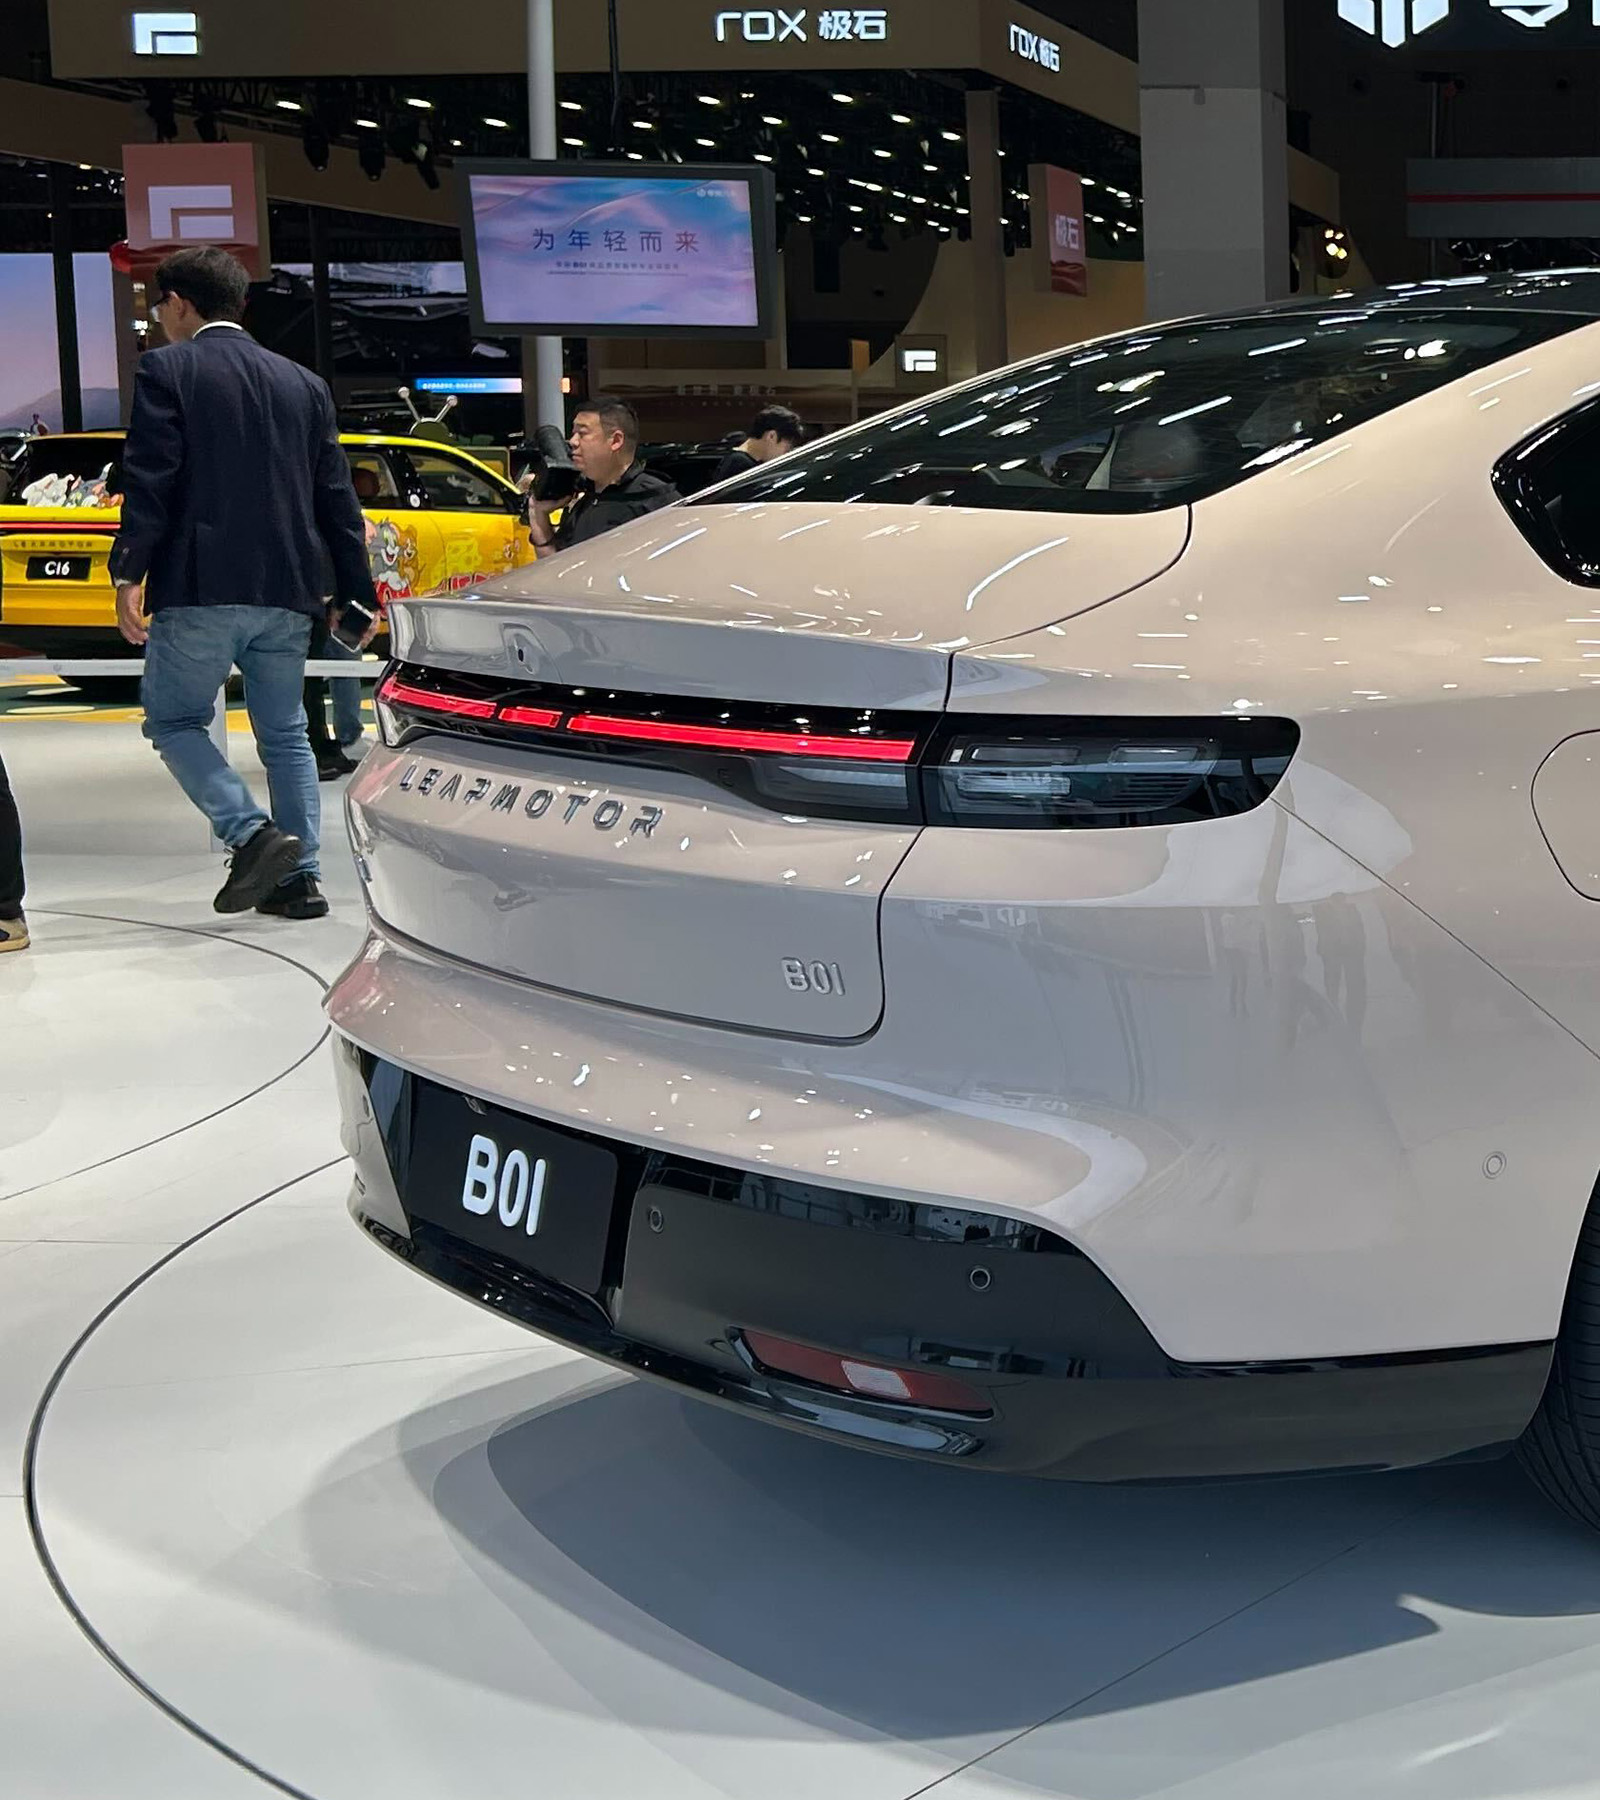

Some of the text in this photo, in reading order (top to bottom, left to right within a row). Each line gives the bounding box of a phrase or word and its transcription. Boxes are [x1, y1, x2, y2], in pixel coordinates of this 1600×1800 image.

[818, 10, 888, 40] 极石
[1038, 38, 1060, 73] 极石
[532, 228, 699, 253] 为年轻而来
[44, 560, 71, 577] C16
[400, 764, 664, 838] LEAPMOTOR
[781, 957, 846, 996] B01
[461, 1133, 548, 1236] B01
